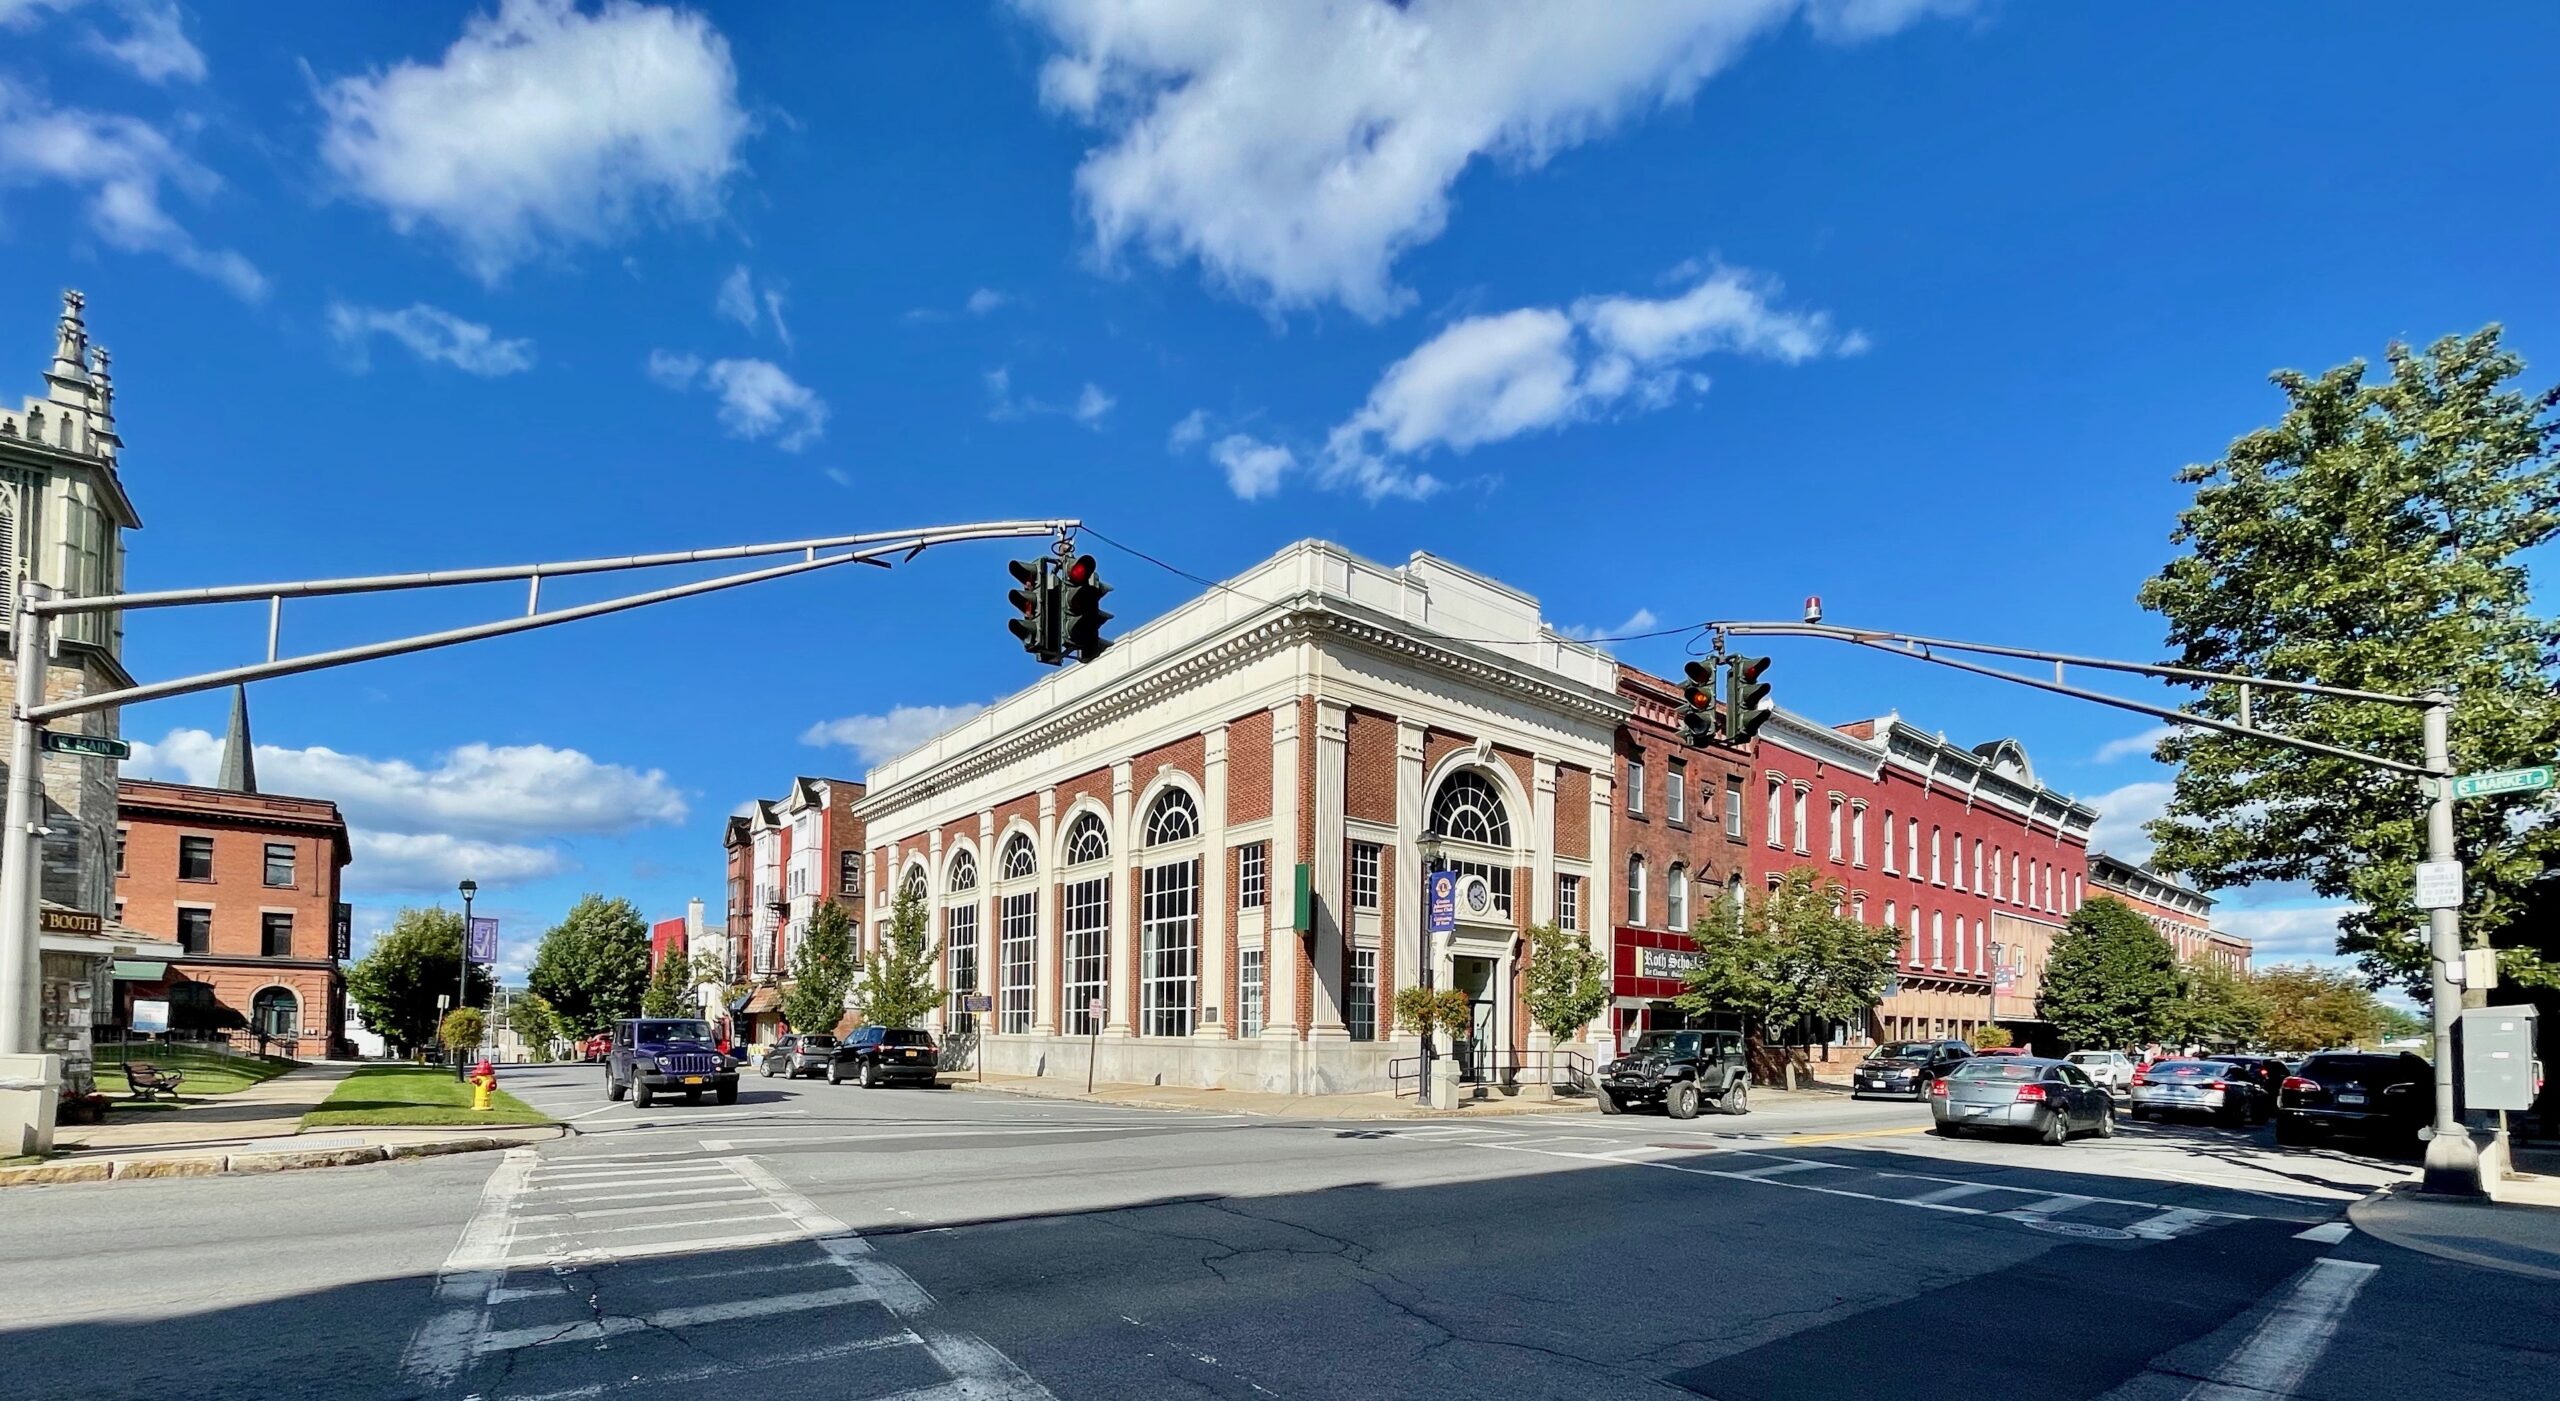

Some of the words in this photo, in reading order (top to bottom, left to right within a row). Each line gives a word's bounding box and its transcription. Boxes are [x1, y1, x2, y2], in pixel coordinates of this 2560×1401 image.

[75, 739, 111, 753] MAIN
[2475, 775, 2533, 791] MARKET
[50, 913, 98, 931] BOOTH
[1644, 950, 1667, 969] Roth
